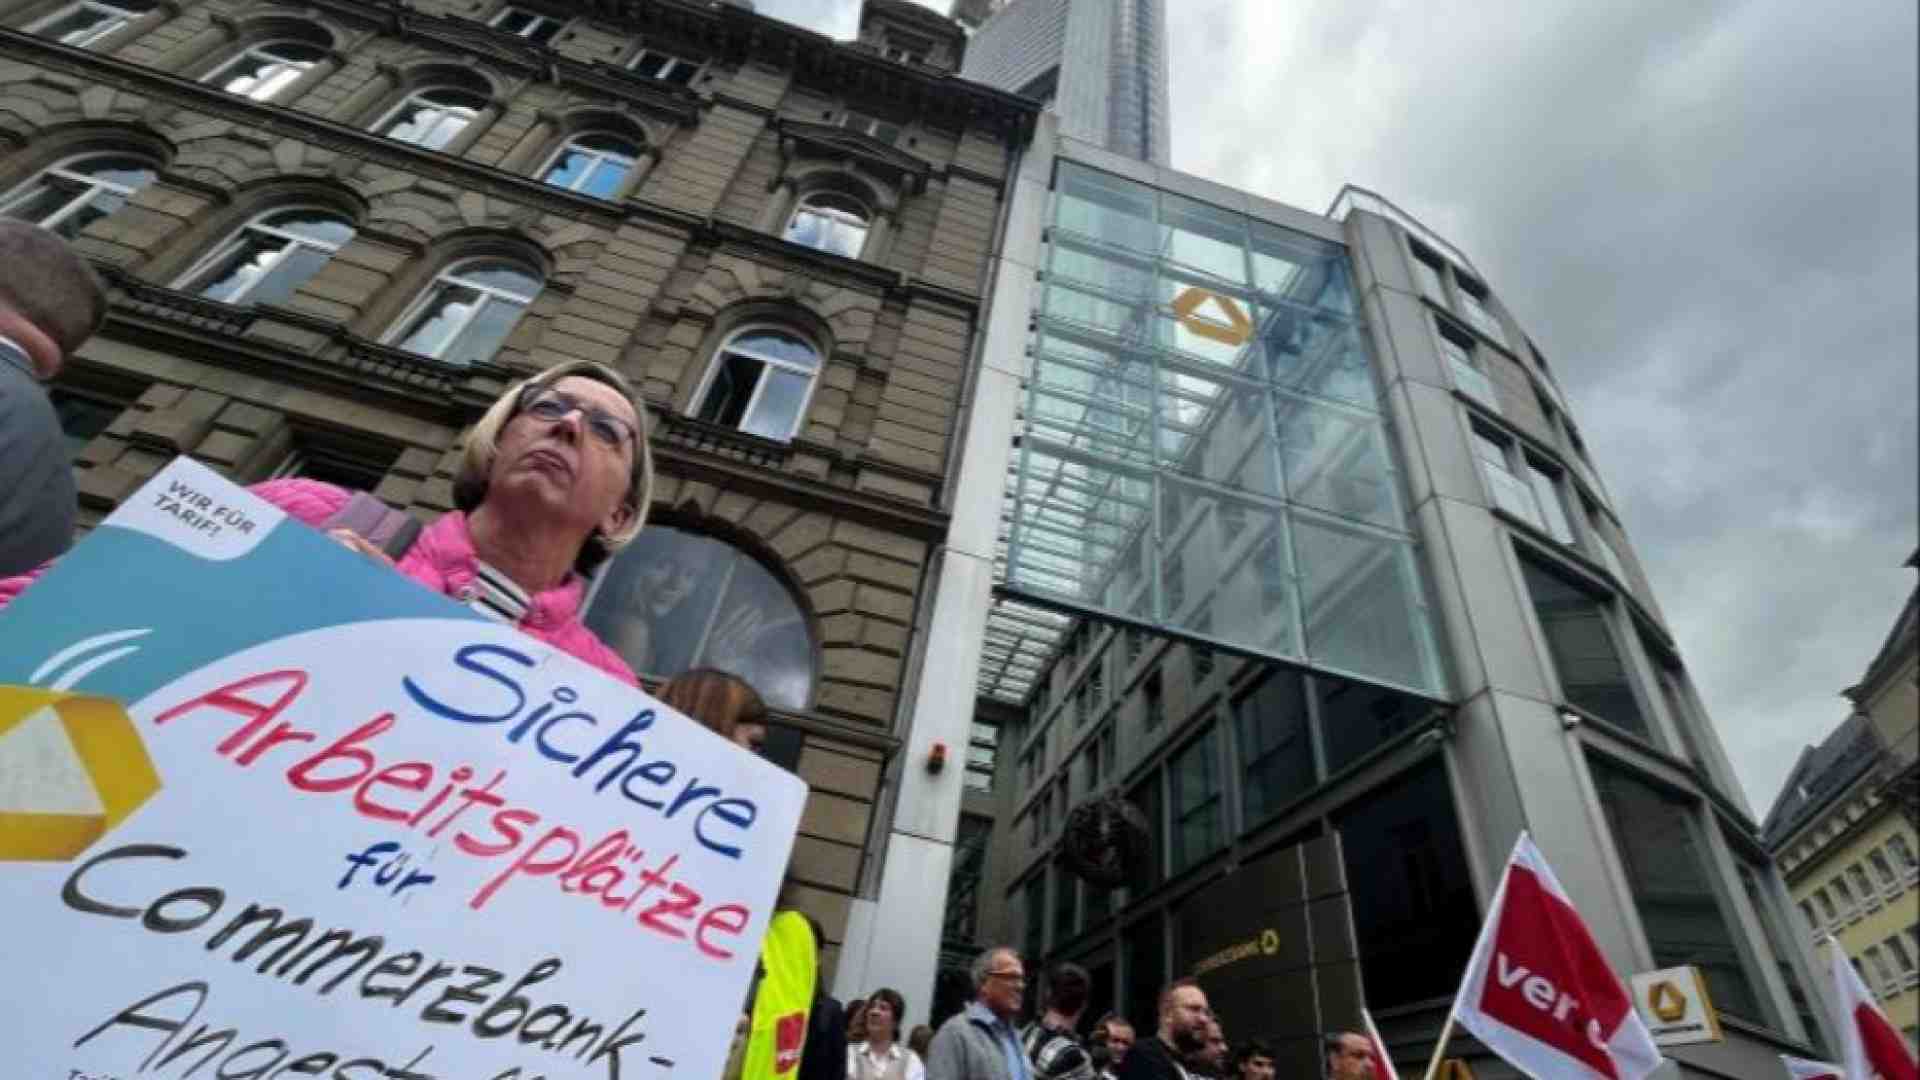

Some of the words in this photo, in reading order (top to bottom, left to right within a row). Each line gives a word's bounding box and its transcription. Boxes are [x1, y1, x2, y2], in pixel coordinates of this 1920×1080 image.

[154, 494, 222, 537] TARIF!
[169, 480, 213, 511] WIR
[212, 506, 256, 535] FÜR
[402, 643, 758, 860] Sichere
[153, 669, 751, 959] Arbeitsplätze
[337, 842, 436, 897] für
